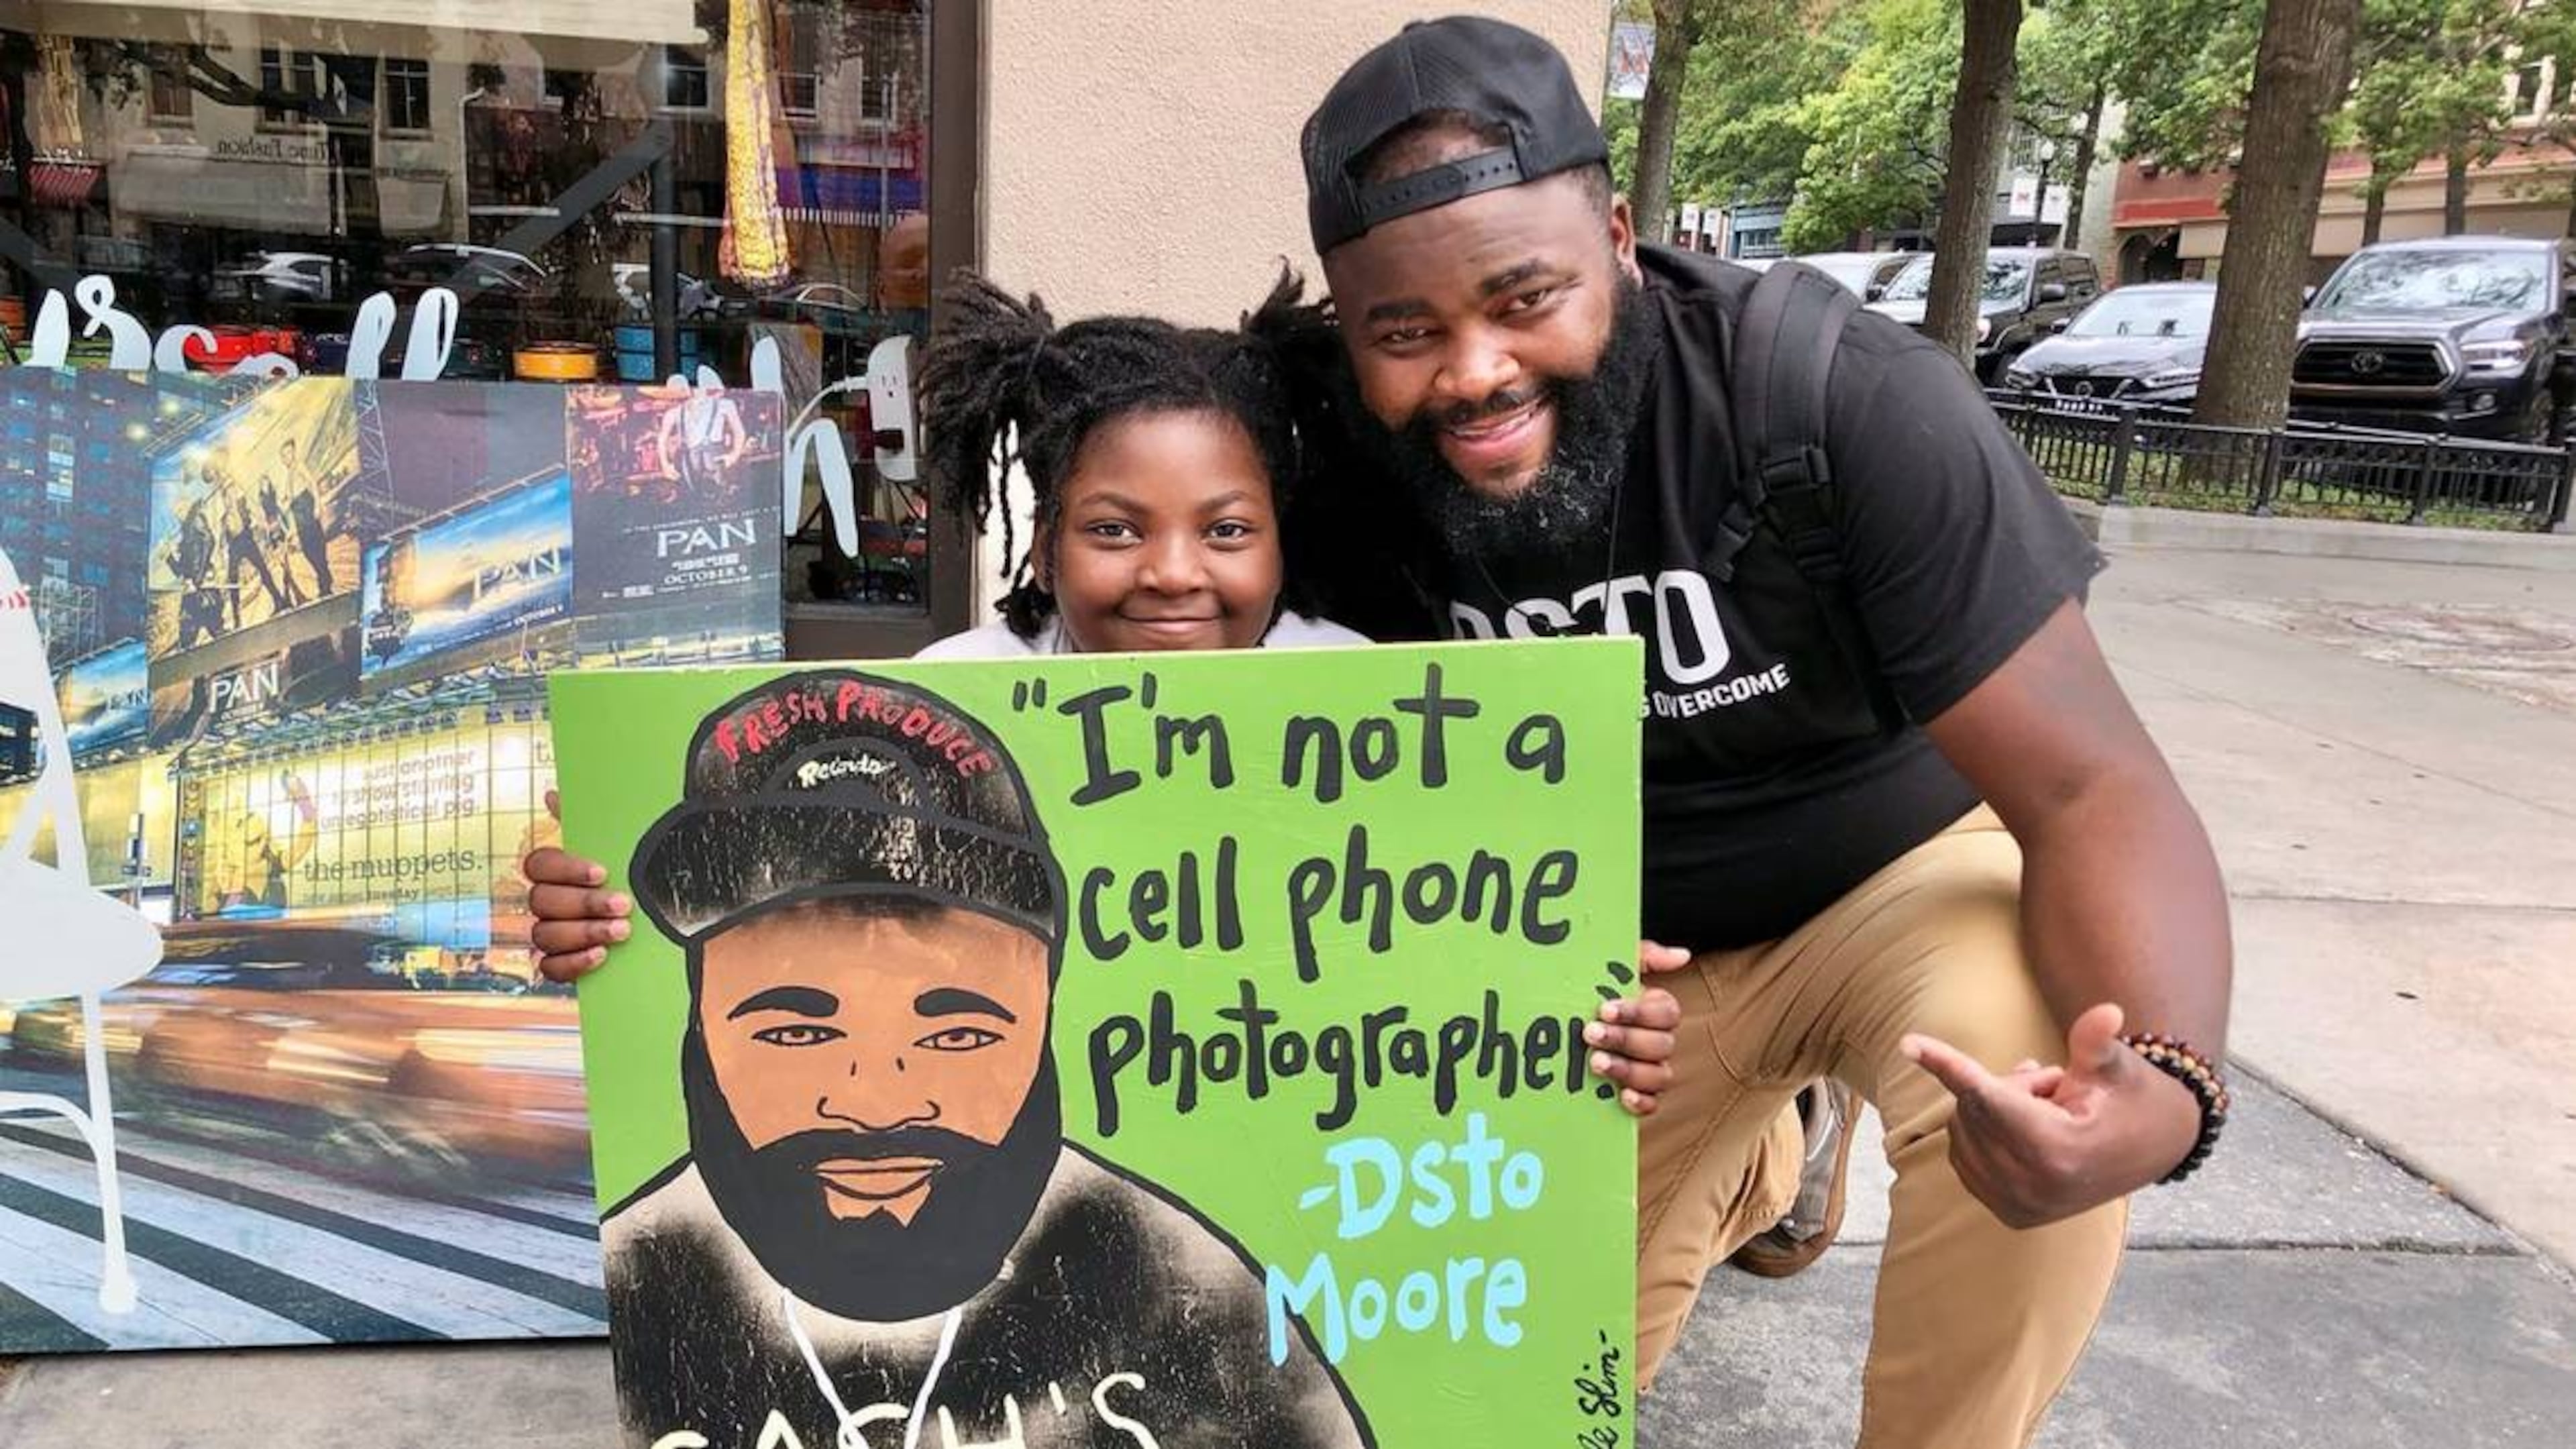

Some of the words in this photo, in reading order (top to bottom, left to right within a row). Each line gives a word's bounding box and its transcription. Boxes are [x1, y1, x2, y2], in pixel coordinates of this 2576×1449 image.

[657, 518, 757, 558] PAN
[473, 544, 563, 600] PAN
[664, 568, 735, 585] OCTOBER
[209, 663, 279, 713] PAN
[1652, 663, 1790, 718] OVERCOME
[715, 691, 826, 763] FRESH
[836, 679, 991, 777] PRODUCE
[1282, 662, 1479, 804] not
[1505, 714, 1565, 784] a
[304, 857, 344, 882] the
[352, 847, 482, 882] muppets.
[1079, 835, 1244, 960] cell
[1287, 824, 1578, 983] phone
[1298, 1112, 1544, 1239] -Dsto
[1265, 1251, 1531, 1368] Moore
